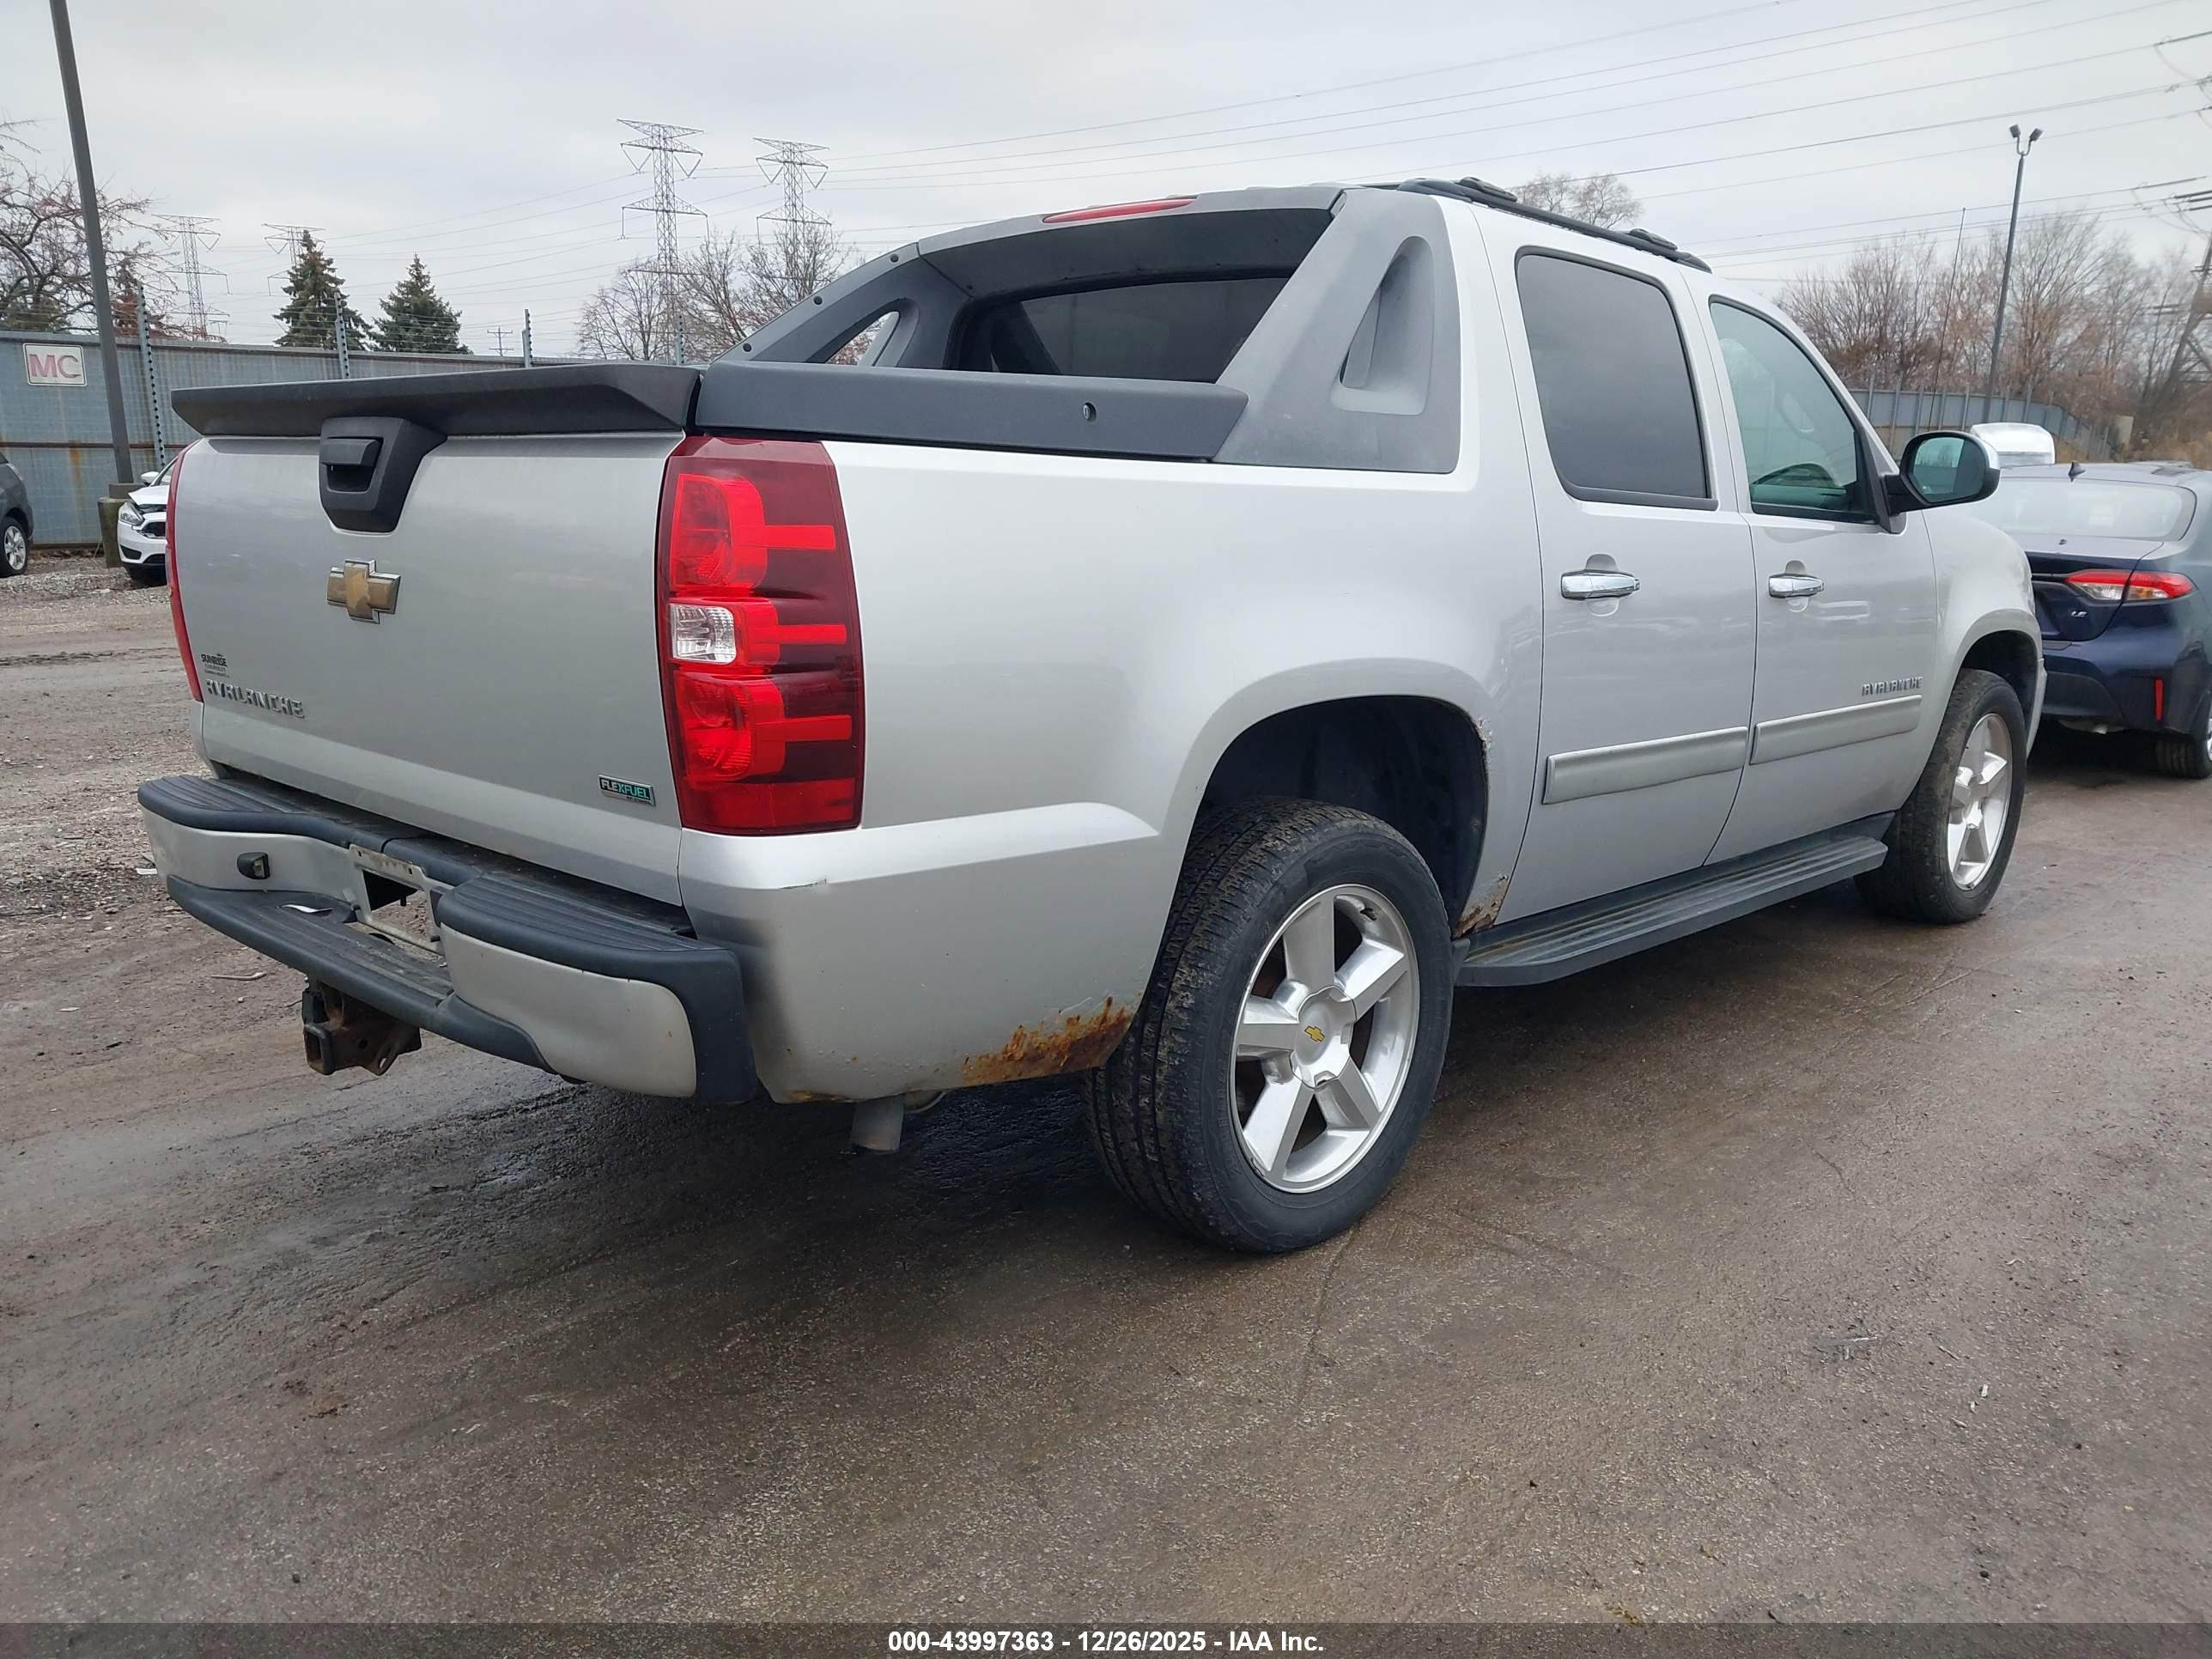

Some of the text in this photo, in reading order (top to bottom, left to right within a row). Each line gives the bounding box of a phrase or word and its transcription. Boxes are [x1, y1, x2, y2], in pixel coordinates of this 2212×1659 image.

[28, 354, 82, 379] MC
[1862, 676, 1923, 696] AVALANCHE
[206, 678, 305, 719] AVALANCHE
[601, 779, 649, 798] FLEXFUEL
